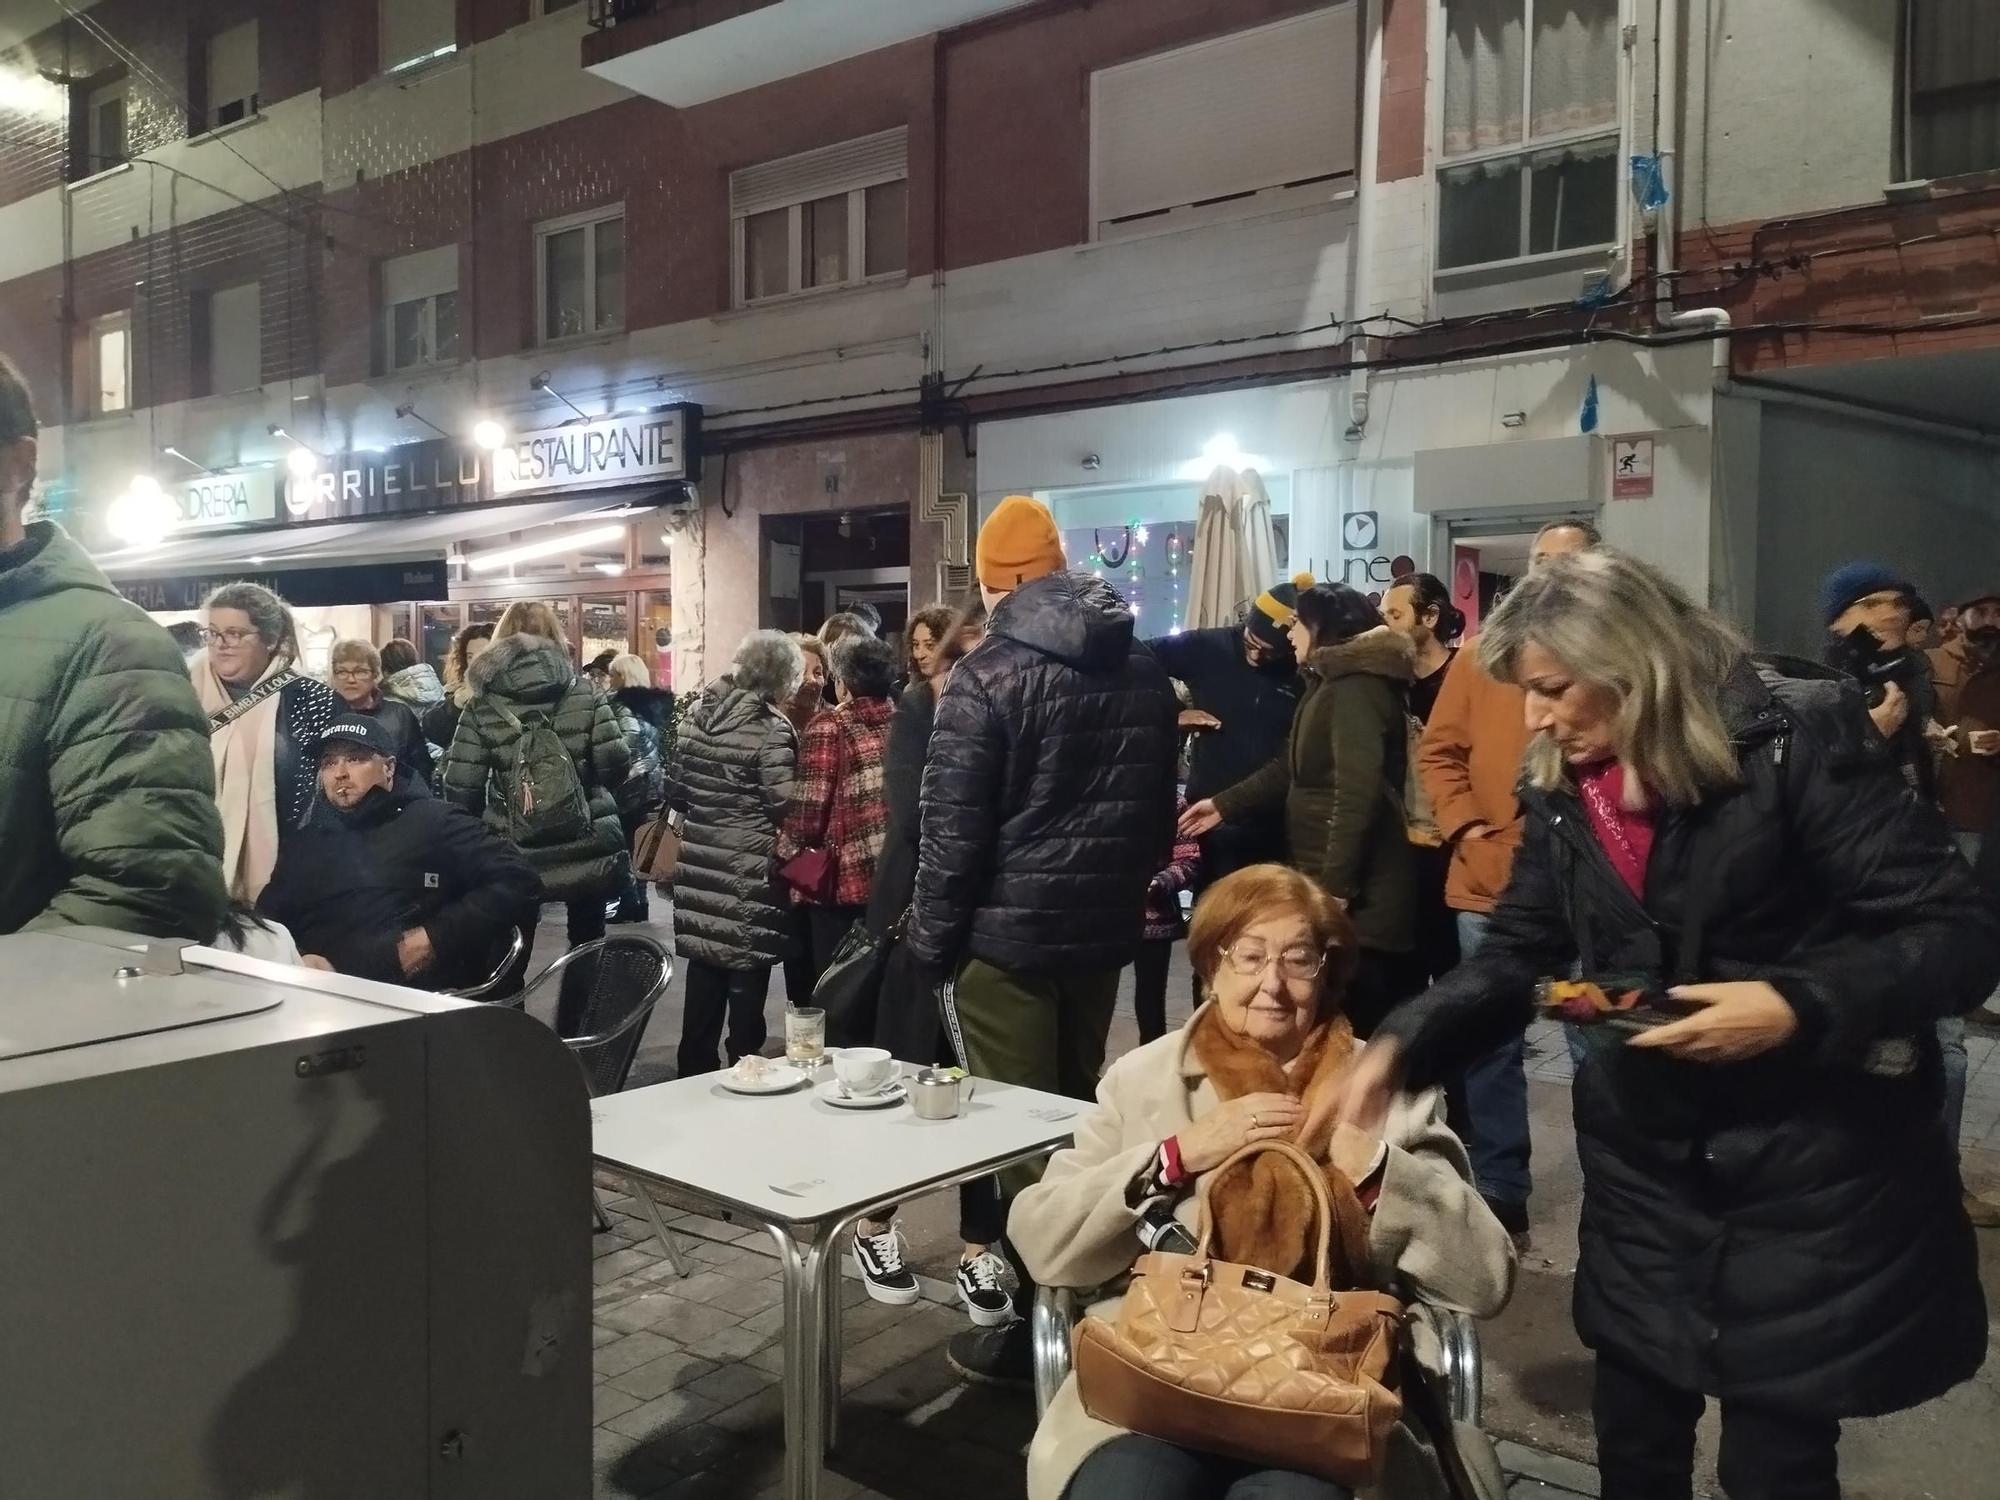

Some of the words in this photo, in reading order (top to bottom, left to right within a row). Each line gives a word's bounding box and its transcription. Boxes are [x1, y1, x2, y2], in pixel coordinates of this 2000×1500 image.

[501, 420, 674, 481] RESTAURANTE
[223, 692, 261, 719] BIMBA
[266, 671, 296, 690] LOLA
